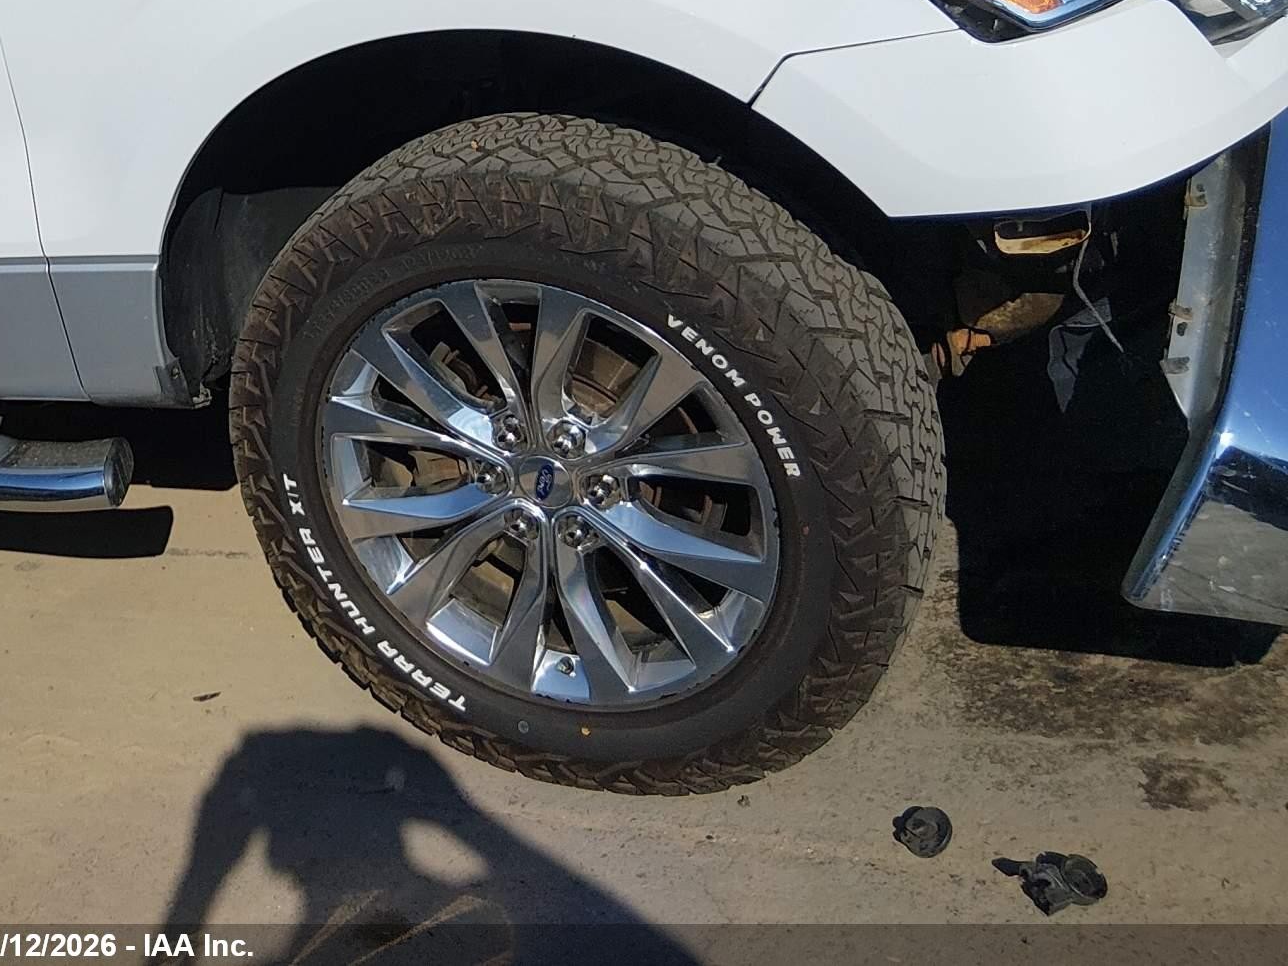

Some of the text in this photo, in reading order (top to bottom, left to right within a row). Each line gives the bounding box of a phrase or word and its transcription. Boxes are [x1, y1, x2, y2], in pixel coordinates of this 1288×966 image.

[667, 313, 801, 478] VENOM POWER
[298, 527, 376, 635] HUNTER
[377, 640, 467, 711] TERRA
